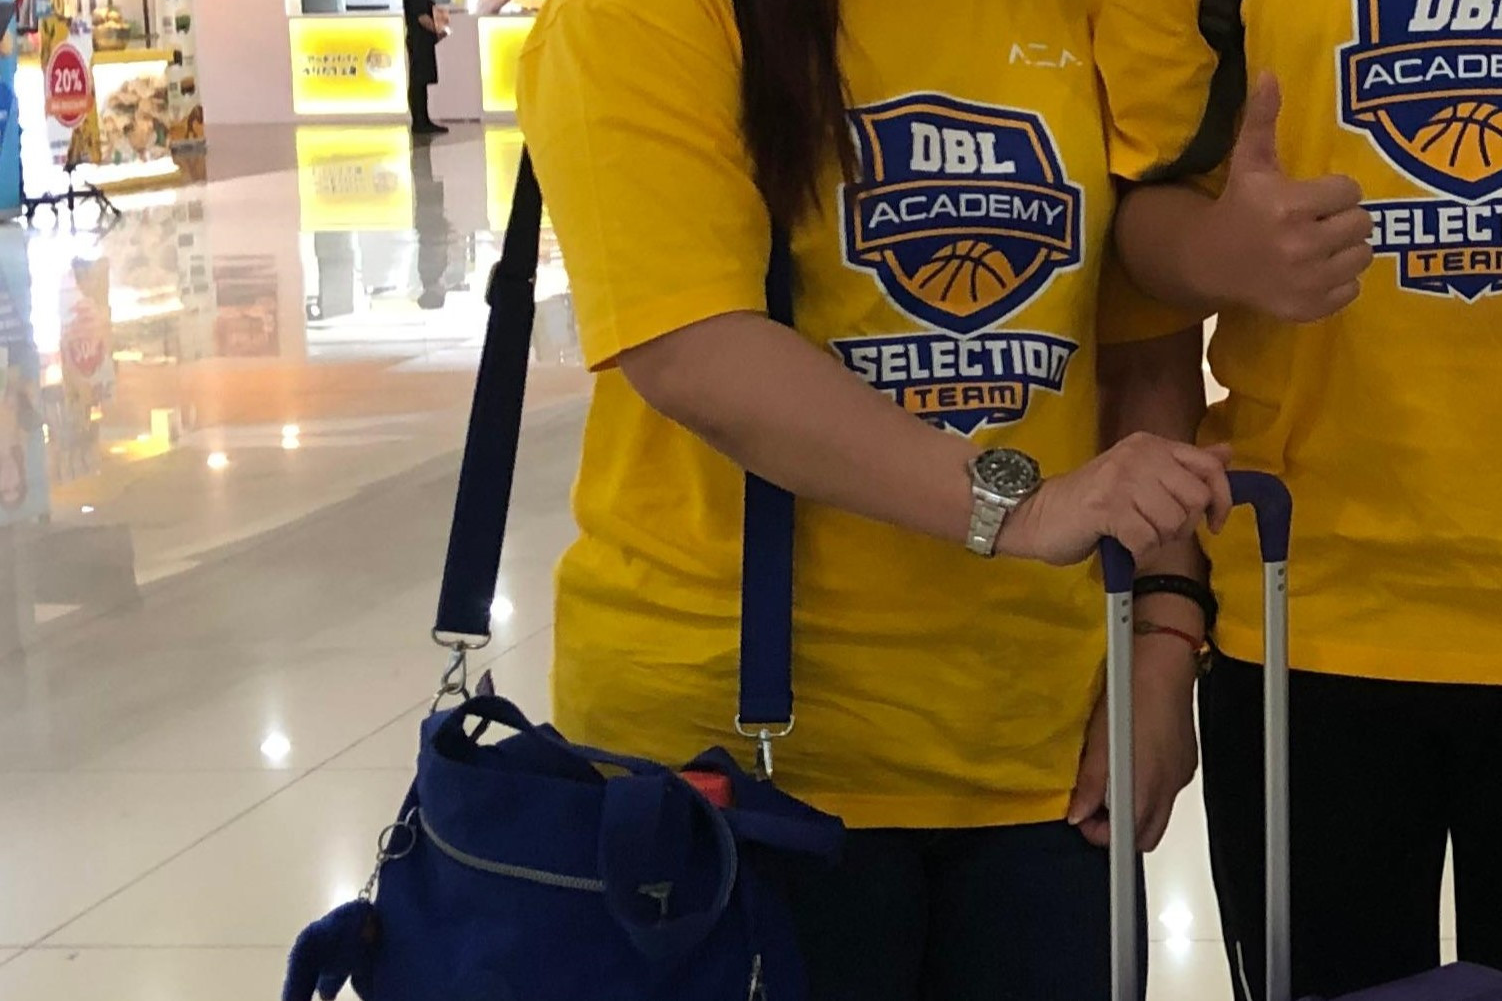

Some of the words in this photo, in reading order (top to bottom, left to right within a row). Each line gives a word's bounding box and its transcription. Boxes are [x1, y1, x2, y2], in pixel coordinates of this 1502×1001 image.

[54, 67, 83, 94] 20%
[910, 121, 1016, 175] DBL
[868, 193, 1064, 229] ACADEMY
[850, 339, 1070, 383] SELECTION
[913, 385, 1017, 409] TEAM
